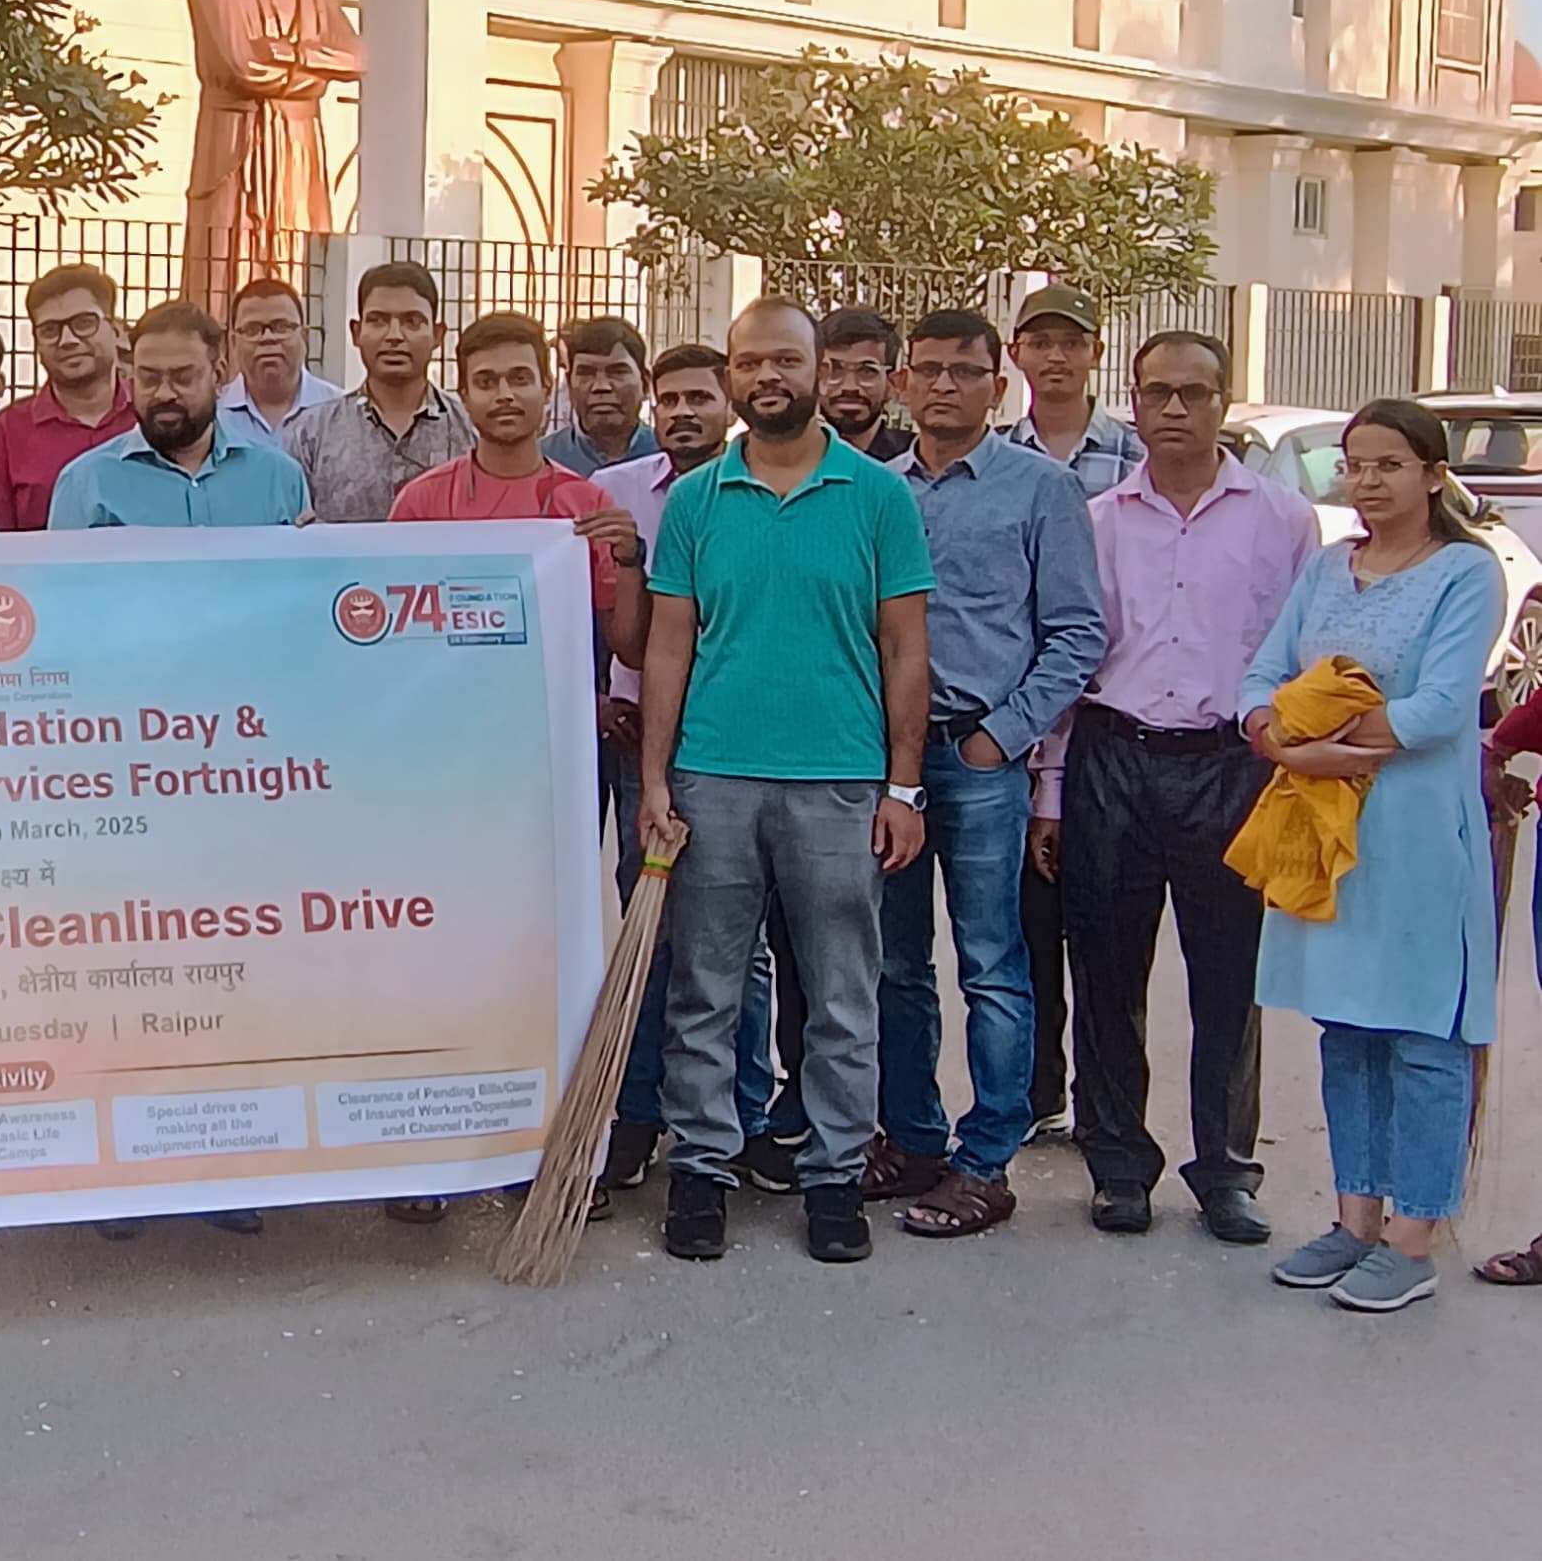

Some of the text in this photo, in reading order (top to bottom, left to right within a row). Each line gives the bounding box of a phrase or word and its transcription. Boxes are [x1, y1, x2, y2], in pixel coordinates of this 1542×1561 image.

[452, 610, 507, 630] ESIC
[29, 666, 70, 686] निगम
[139, 707, 220, 747] Day
[235, 704, 268, 740] &
[129, 755, 333, 801] Fortnight
[95, 815, 149, 837] 2025
[38, 856, 57, 887] में
[300, 888, 436, 934] Drive
[18, 963, 77, 995] क्षेत्रीय
[88, 959, 174, 990] कार्यालय
[184, 959, 246, 993] रायपुर
[141, 1010, 225, 1038] Raipur
[338, 1088, 404, 1106] Clearance
[406, 1086, 422, 1102] of
[424, 1083, 477, 1102] Pending
[146, 1100, 259, 1121] Special drive on
[349, 1107, 363, 1123] of
[365, 1104, 416, 1122] Insured
[33, 1126, 61, 1141] Life
[156, 1115, 253, 1137] making all the
[381, 1121, 406, 1137] and
[409, 1118, 463, 1136] Channel
[132, 1131, 280, 1157] equipment functional
